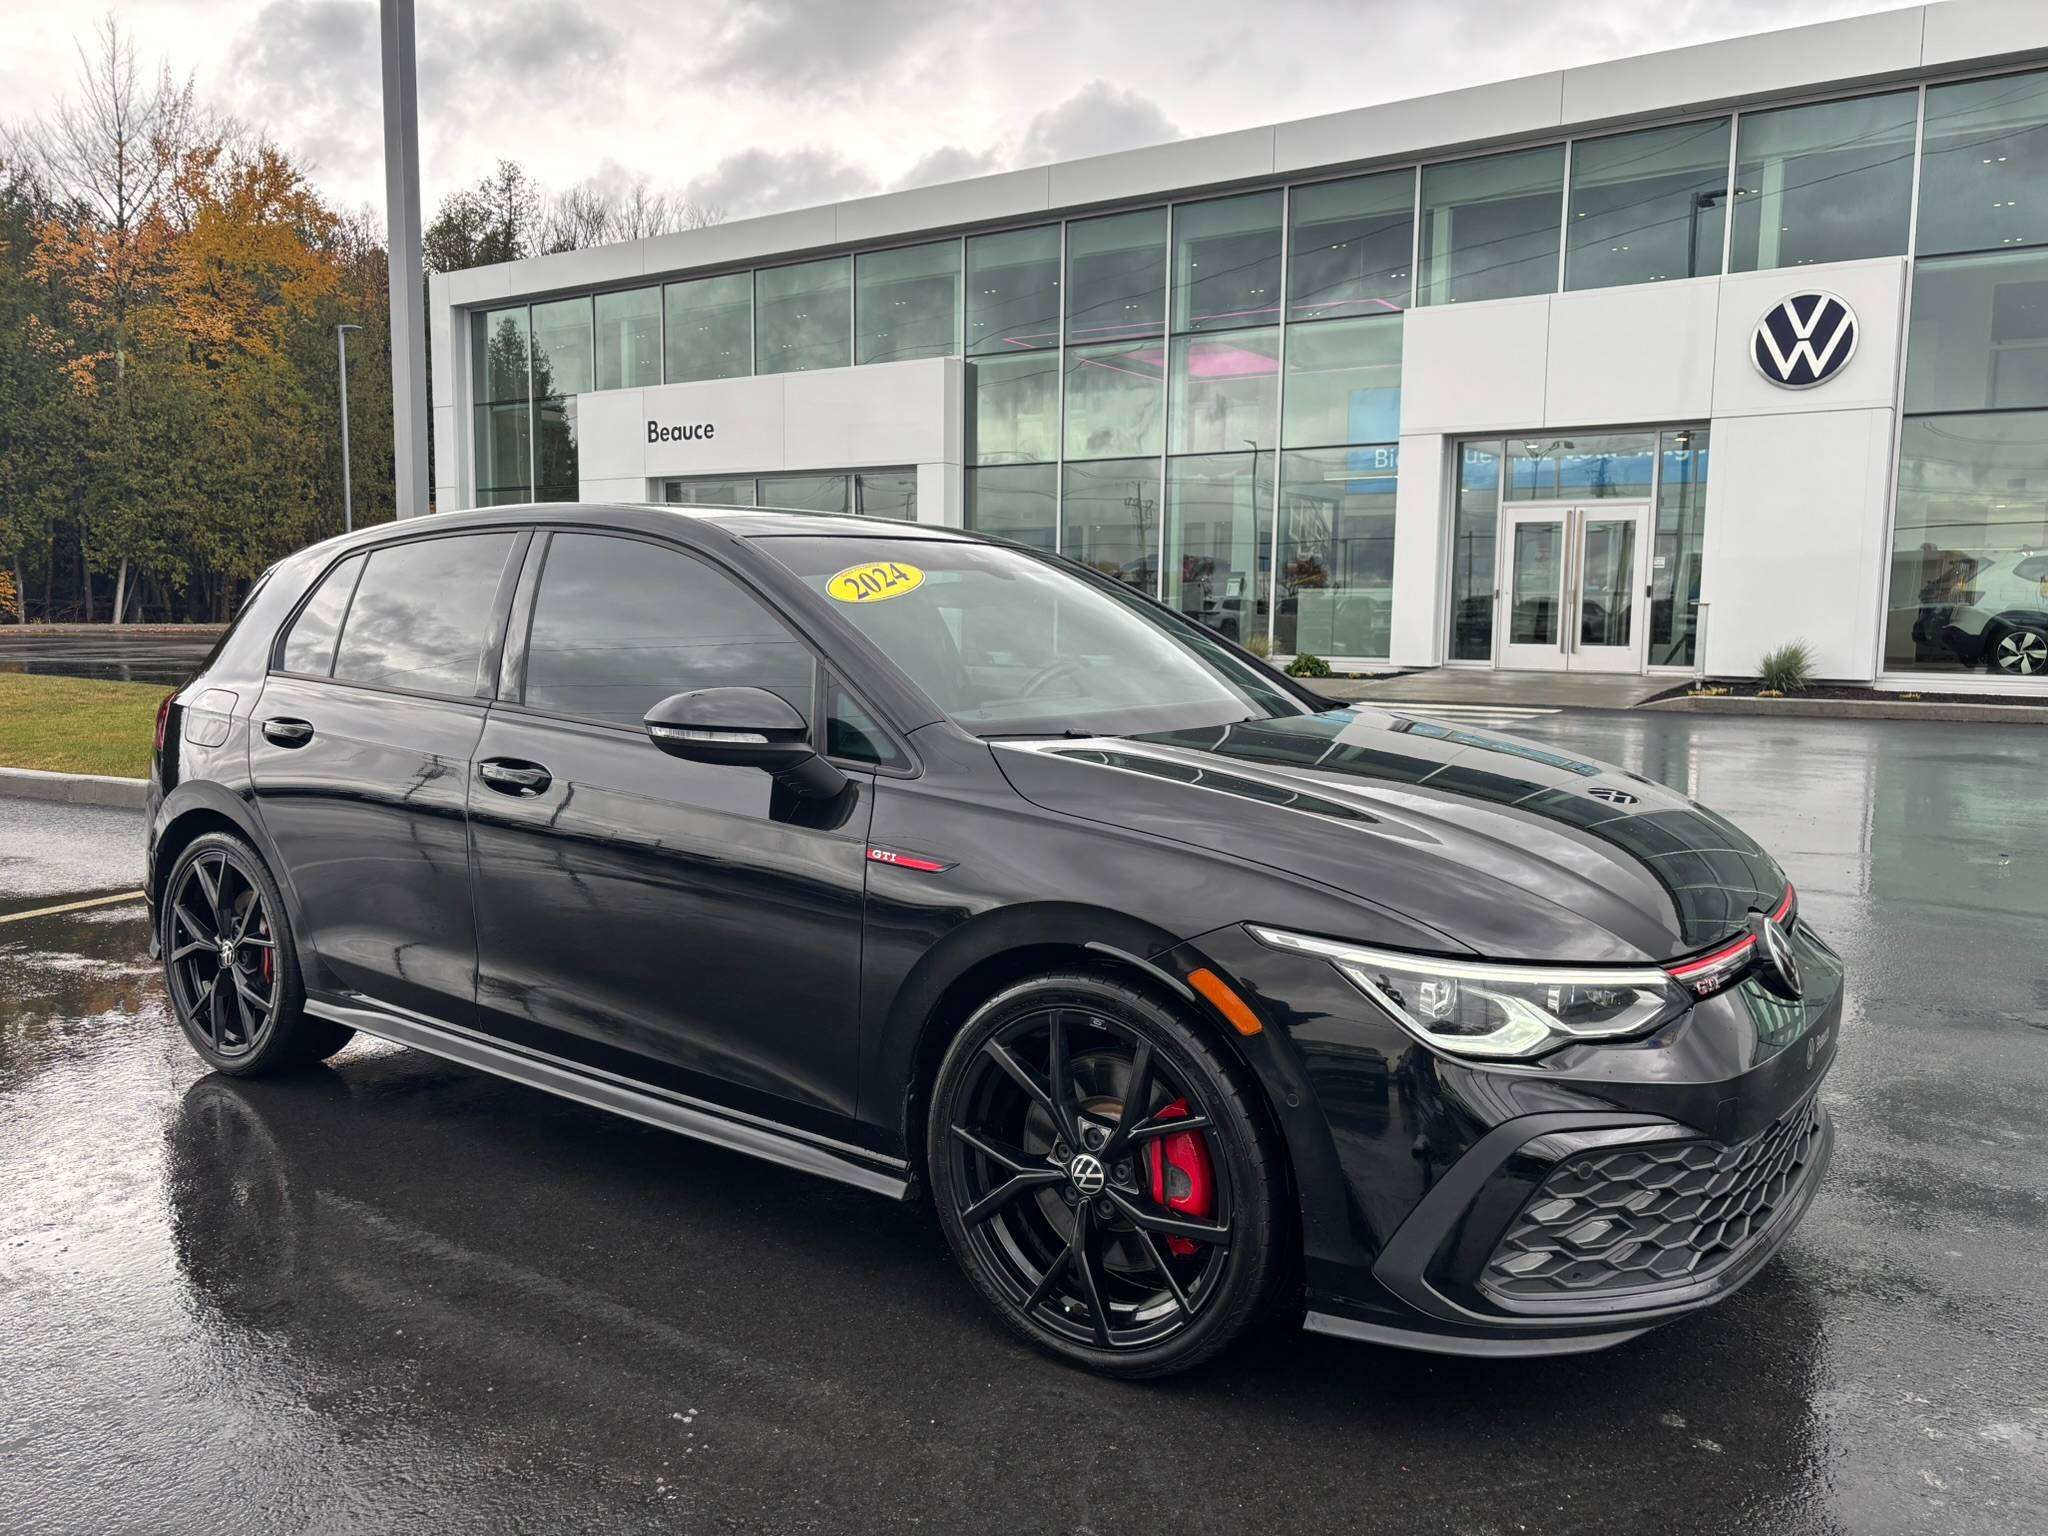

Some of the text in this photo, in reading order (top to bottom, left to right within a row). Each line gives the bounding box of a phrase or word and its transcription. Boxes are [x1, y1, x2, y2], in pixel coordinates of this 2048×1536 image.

[1750, 290, 1858, 390] VW
[647, 420, 714, 443] Beauce
[844, 563, 910, 600] 2024
[872, 849, 897, 862] GTI
